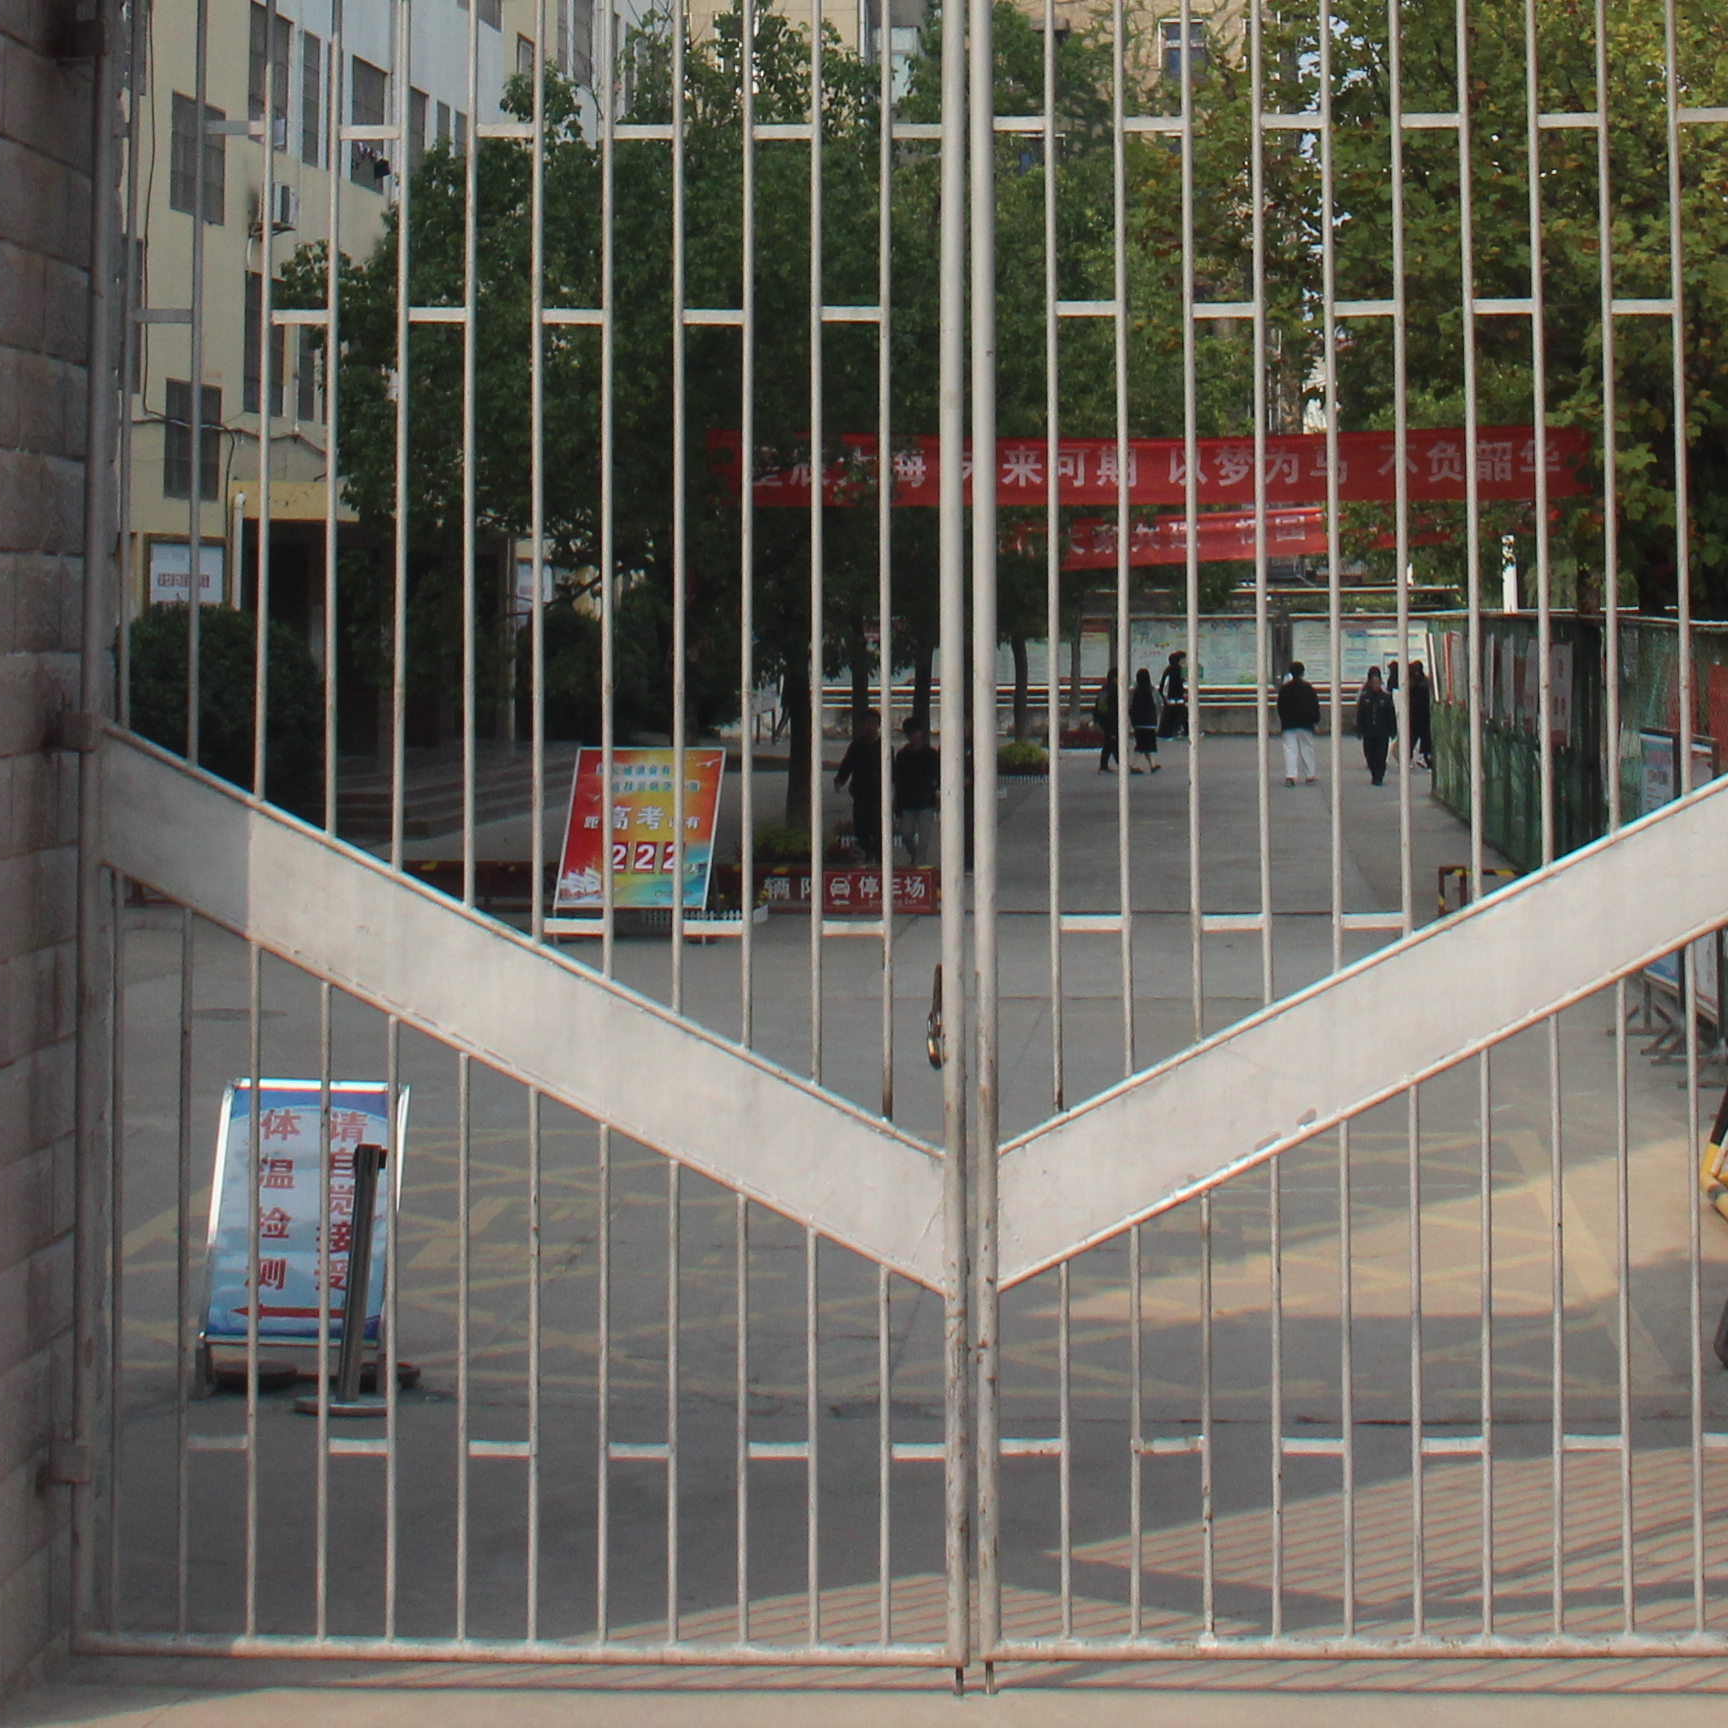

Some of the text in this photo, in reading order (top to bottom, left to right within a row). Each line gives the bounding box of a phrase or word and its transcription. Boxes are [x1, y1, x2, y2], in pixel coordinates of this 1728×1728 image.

[960, 445, 1137, 488] 来可期
[1169, 444, 1348, 487] 以梦为马
[1378, 438, 1562, 484] 不负韶华
[583, 805, 700, 831] 距高考有
[244, 1108, 302, 1291] 体温检测
